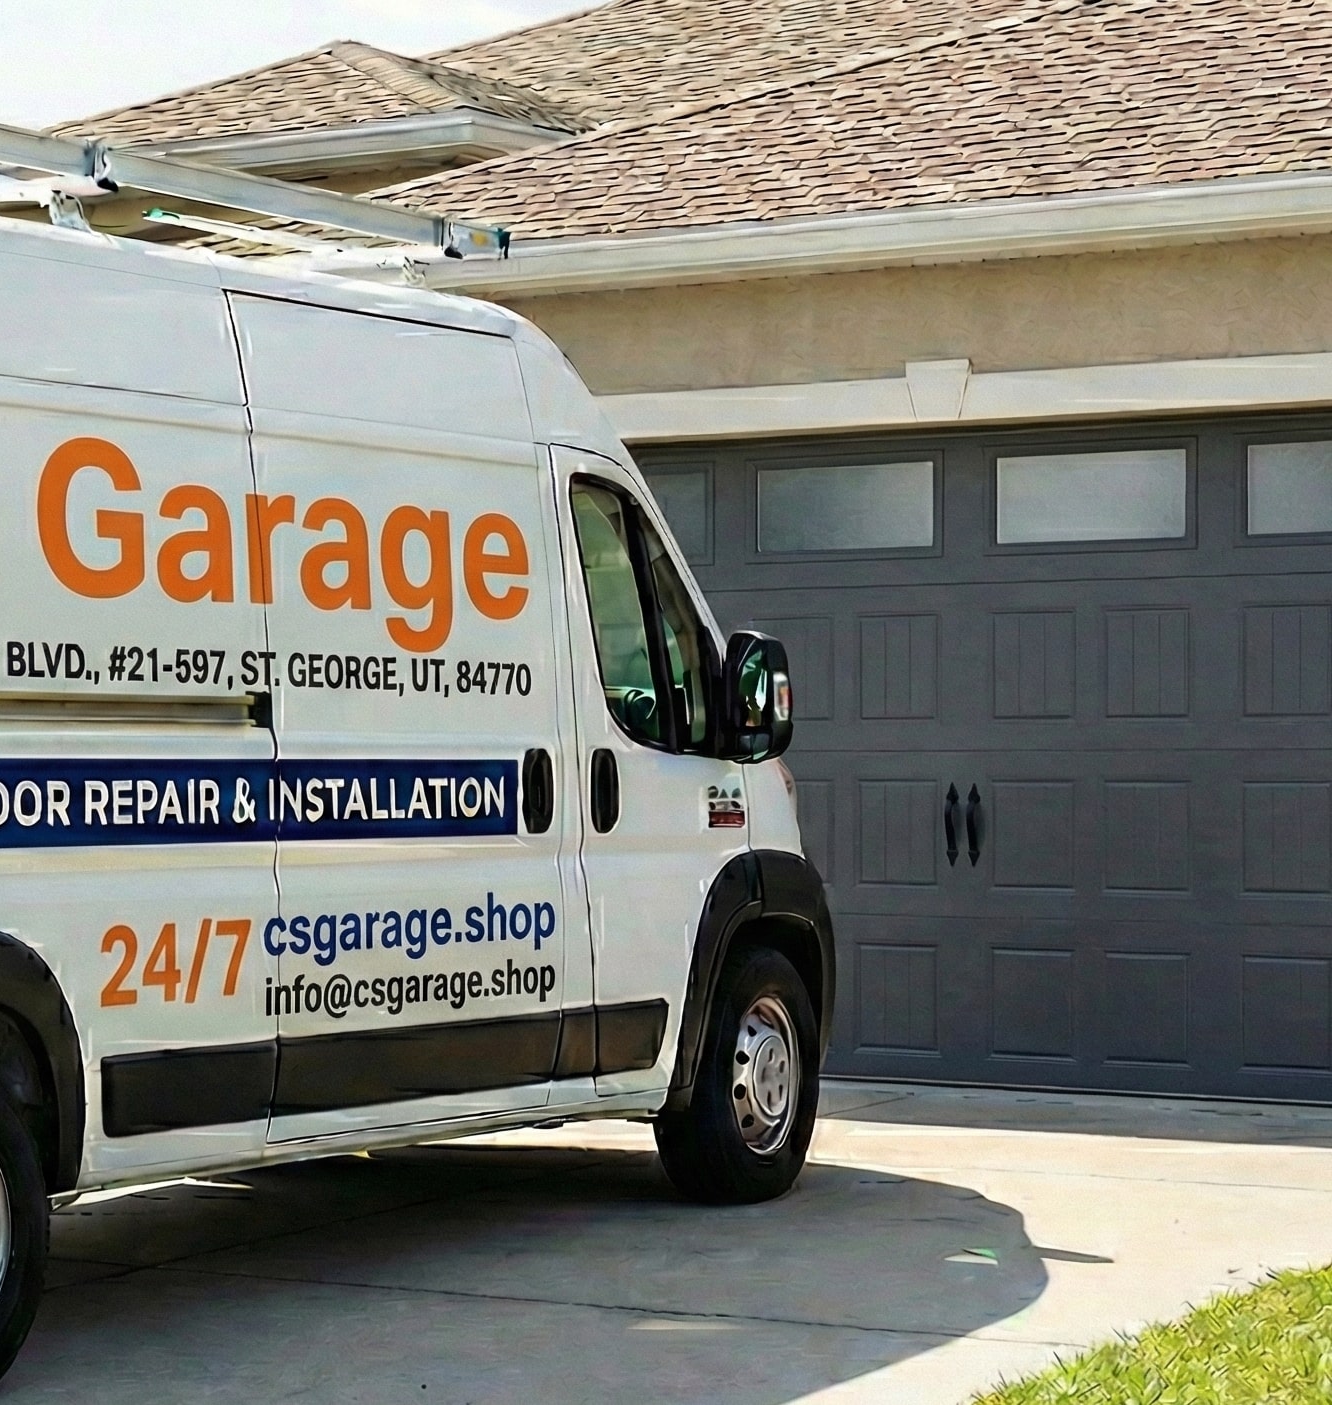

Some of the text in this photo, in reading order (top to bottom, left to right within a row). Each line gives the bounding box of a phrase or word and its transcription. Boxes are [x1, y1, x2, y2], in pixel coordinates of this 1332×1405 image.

[36, 436, 530, 653] Garage
[6, 641, 100, 685] BLVD.,
[107, 645, 235, 690] #21-597,
[240, 650, 281, 688] ST.
[287, 652, 405, 698] GEORGE,
[411, 658, 450, 699] UT,
[455, 661, 532, 697] 84770
[84, 778, 220, 826] REPAIR
[232, 777, 257, 823] &
[269, 775, 506, 823] INSTALLATION
[100, 917, 252, 1009] 24/7
[264, 892, 556, 967] csgarage.shop
[265, 958, 556, 1020] info@csgarage.shop
